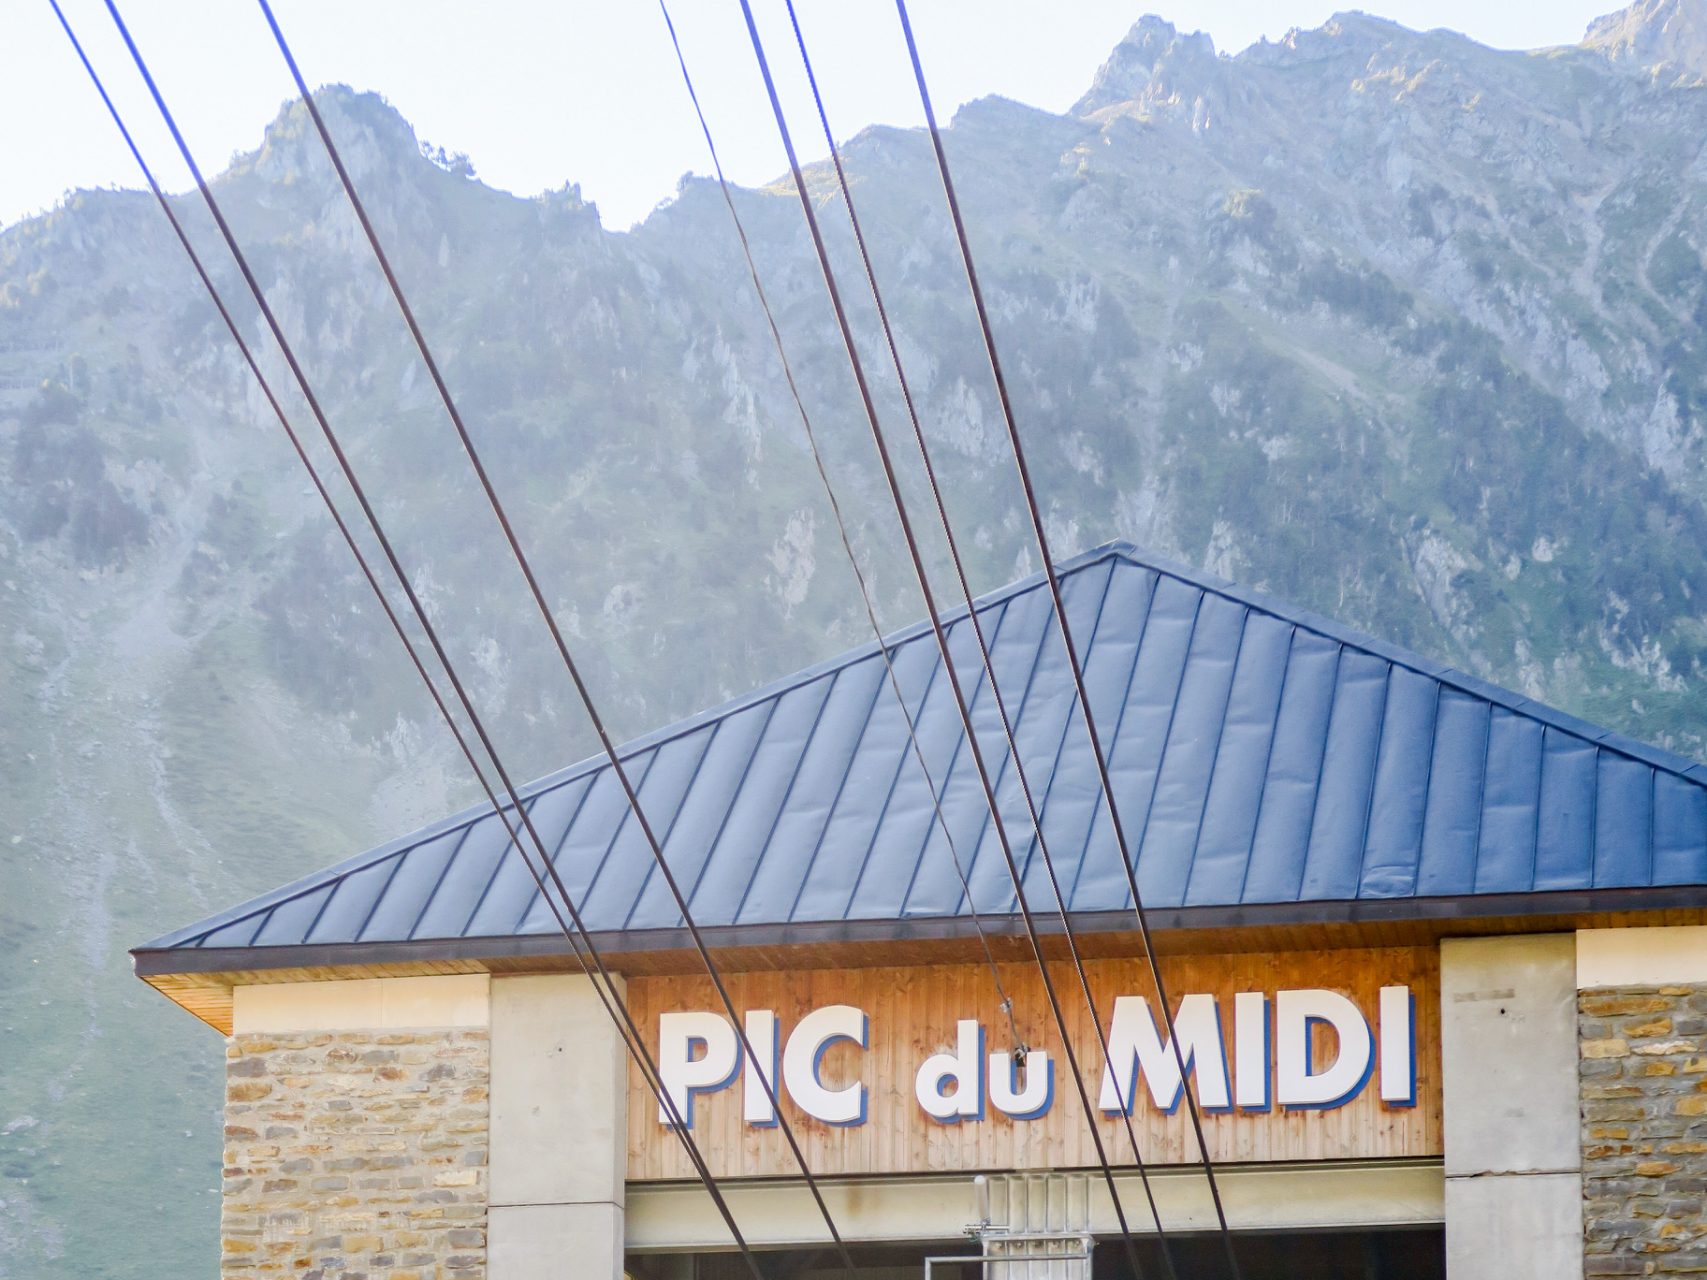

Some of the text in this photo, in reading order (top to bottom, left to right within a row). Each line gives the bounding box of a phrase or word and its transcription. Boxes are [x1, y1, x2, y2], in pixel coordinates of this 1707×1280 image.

[658, 985, 1416, 1128] PIC du MIDI
